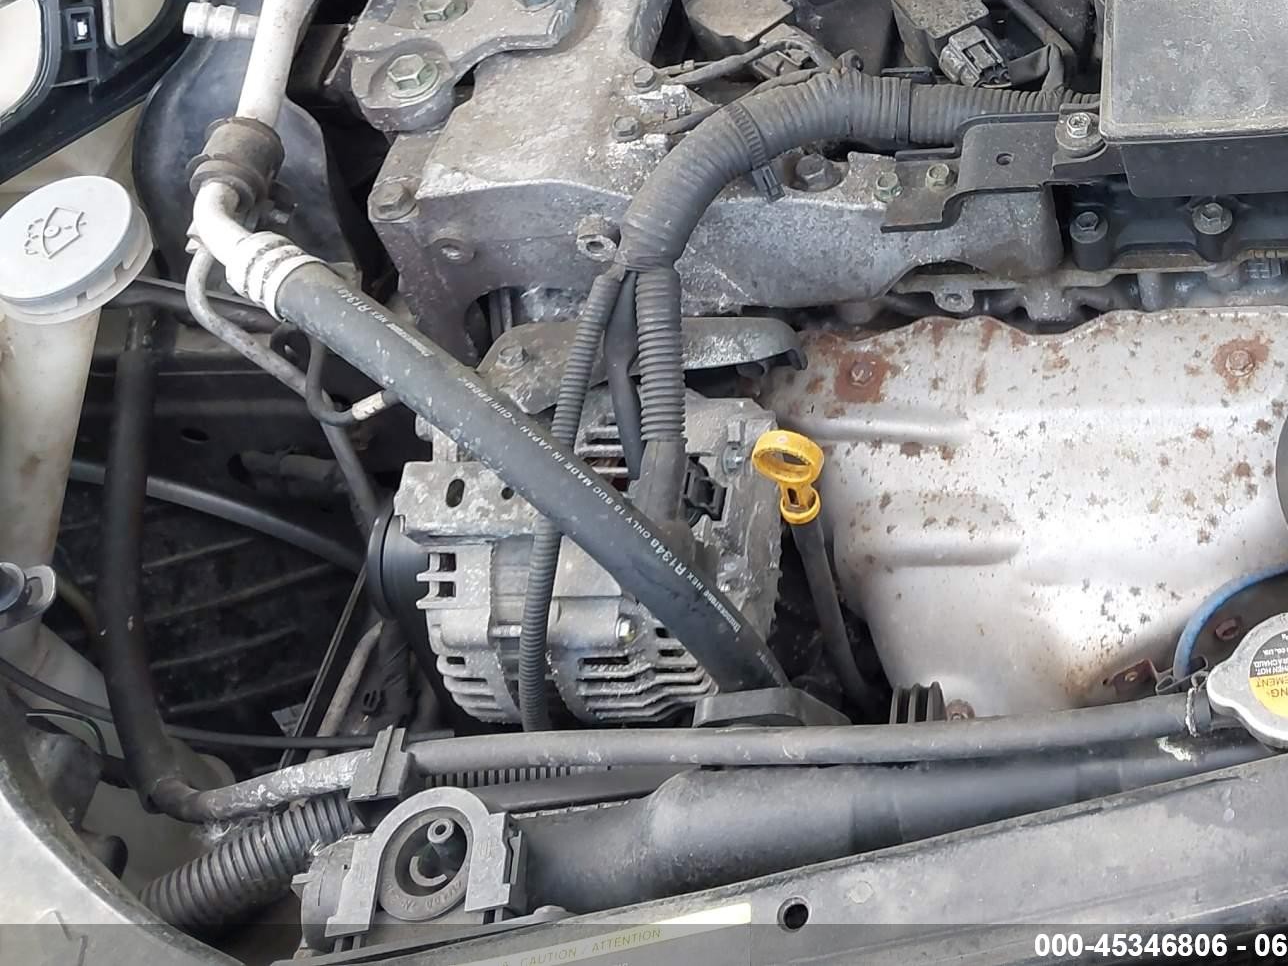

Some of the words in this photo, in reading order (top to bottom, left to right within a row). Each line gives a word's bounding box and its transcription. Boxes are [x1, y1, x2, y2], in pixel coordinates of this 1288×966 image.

[519, 423, 553, 452] JAPAN
[551, 450, 565, 463] IN
[564, 460, 593, 487] MADE
[625, 514, 652, 540] ONLY
[520, 946, 578, 966] CAUTION
[592, 928, 662, 953] ATTENTION
